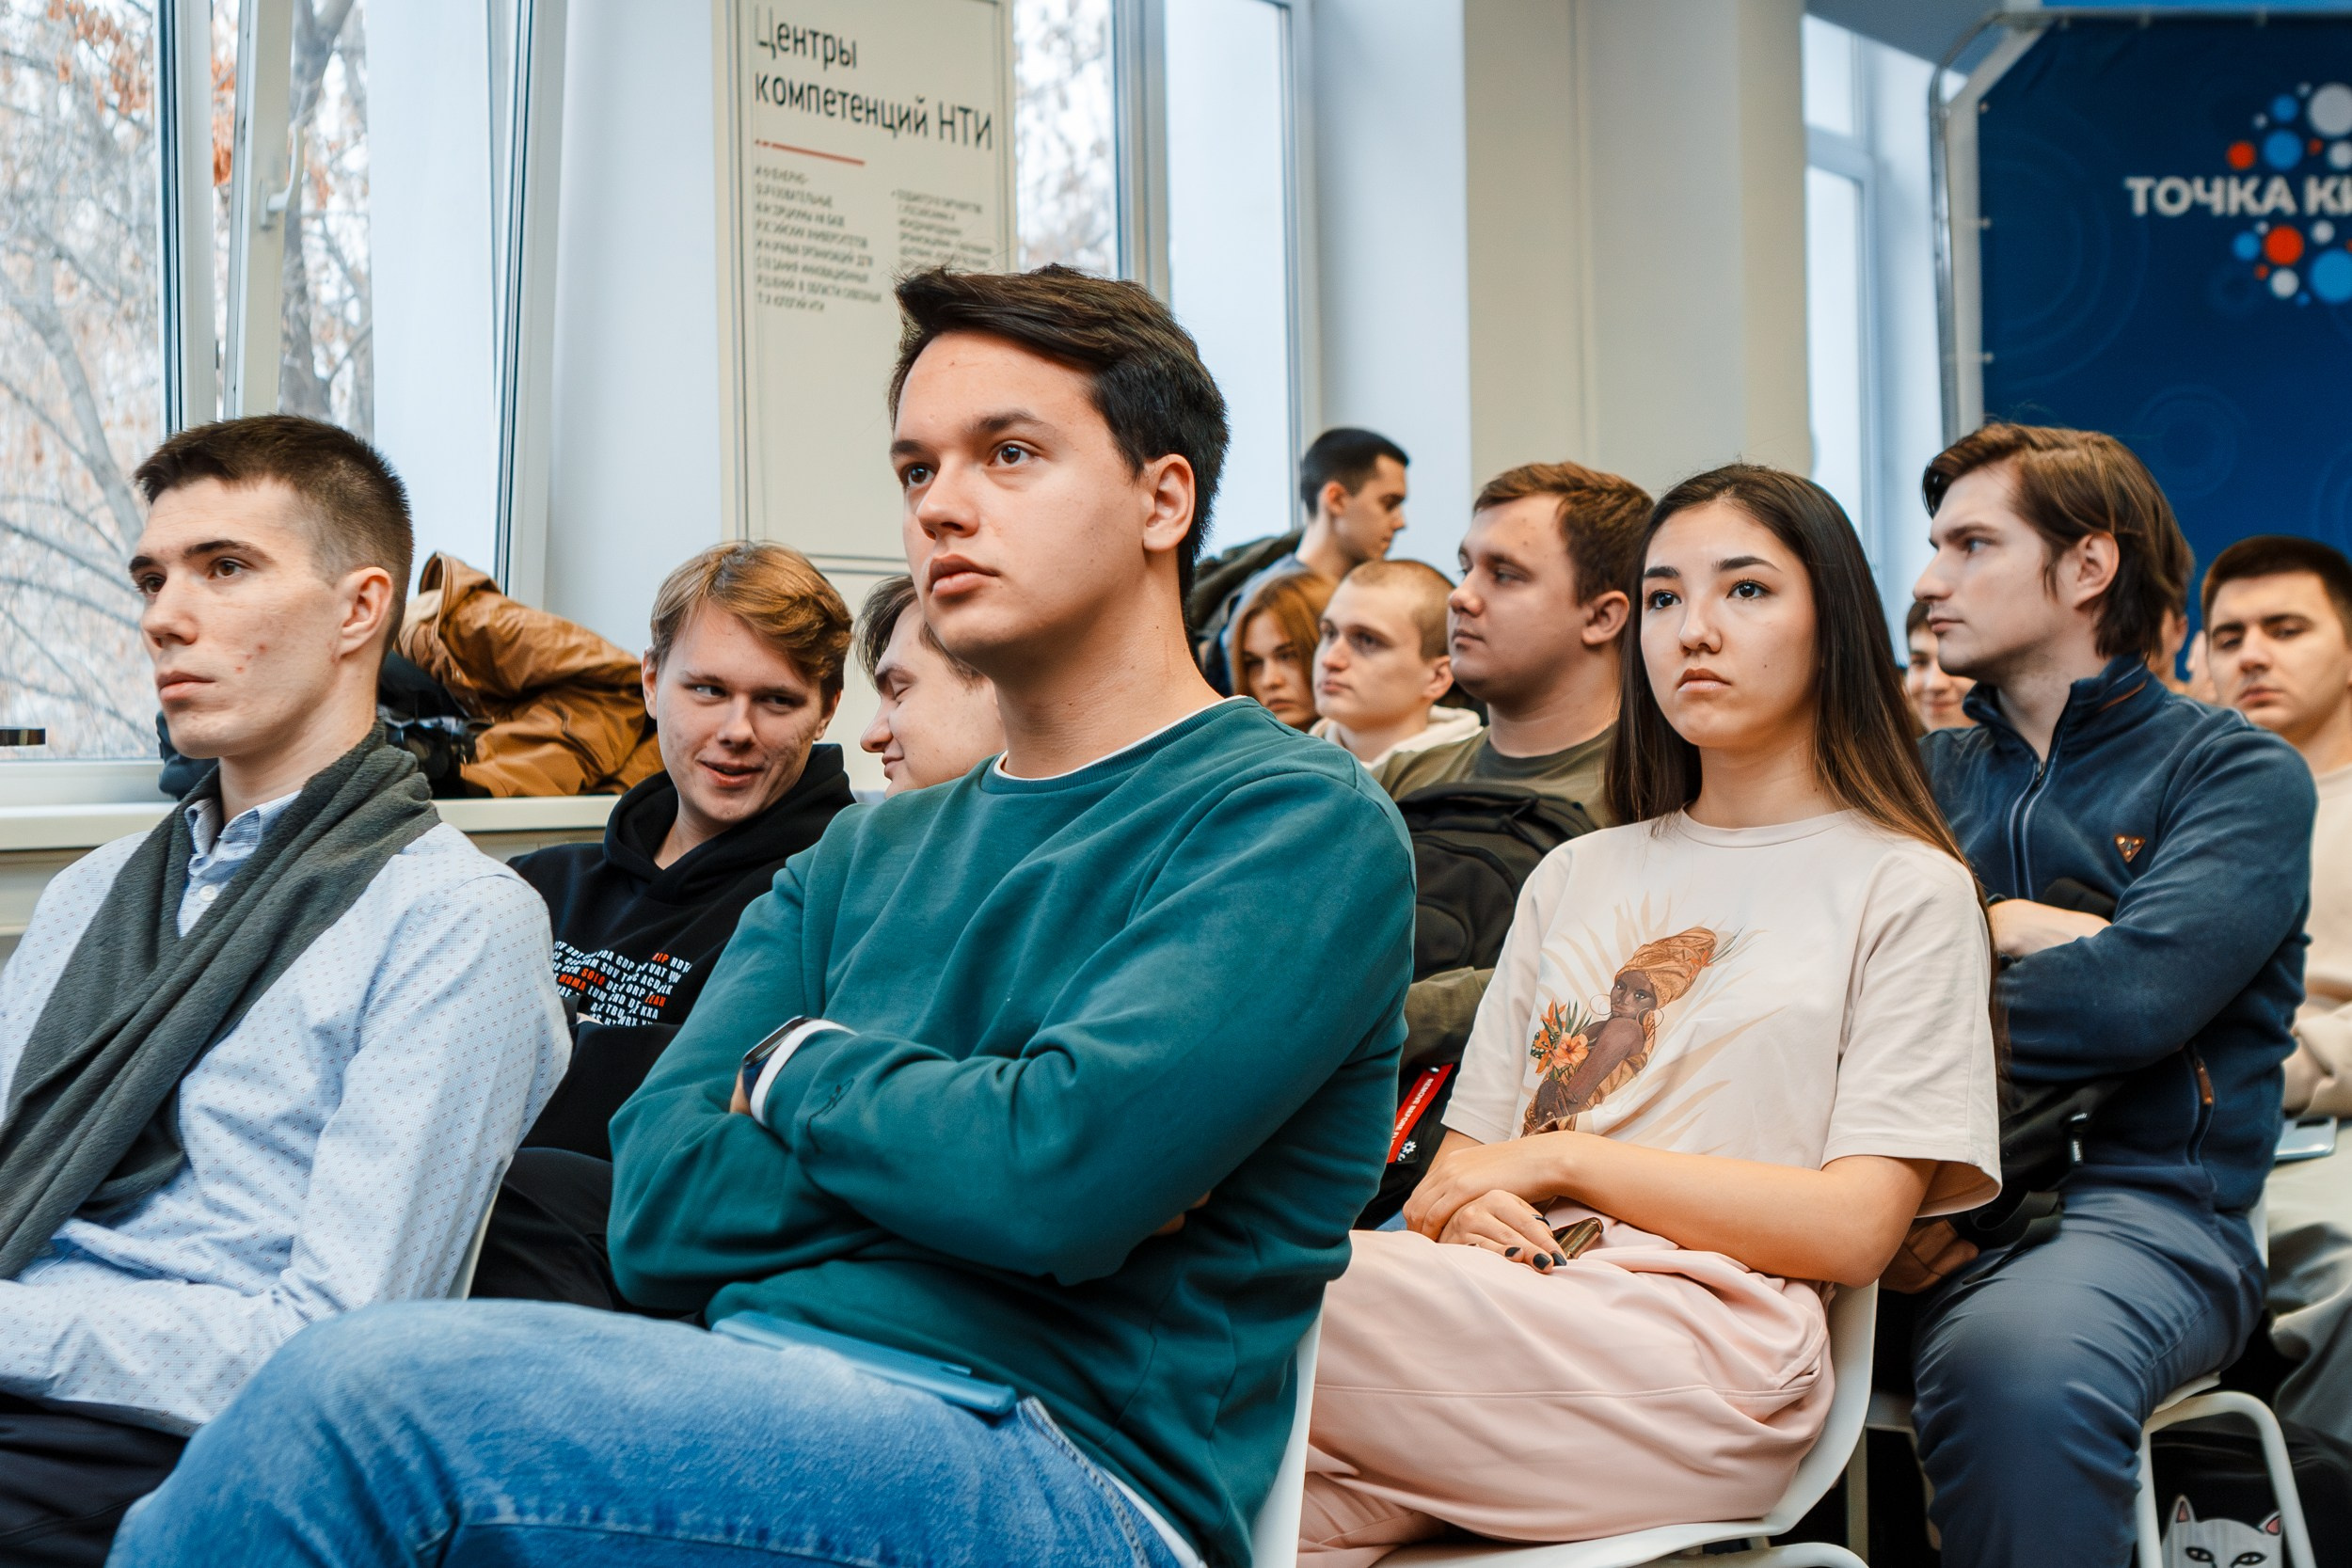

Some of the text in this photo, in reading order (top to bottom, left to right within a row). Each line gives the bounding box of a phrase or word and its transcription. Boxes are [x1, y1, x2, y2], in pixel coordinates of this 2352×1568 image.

[755, 5, 857, 71] Центры
[755, 72, 993, 151] компетенций НТИ
[2124, 175, 2352, 217] ТОЧКА К
[580, 968, 605, 986] SOLO
[600, 962, 620, 978] SUV
[615, 955, 635, 971] GDP
[649, 963, 668, 978] VAT
[587, 985, 607, 1002] LUM
